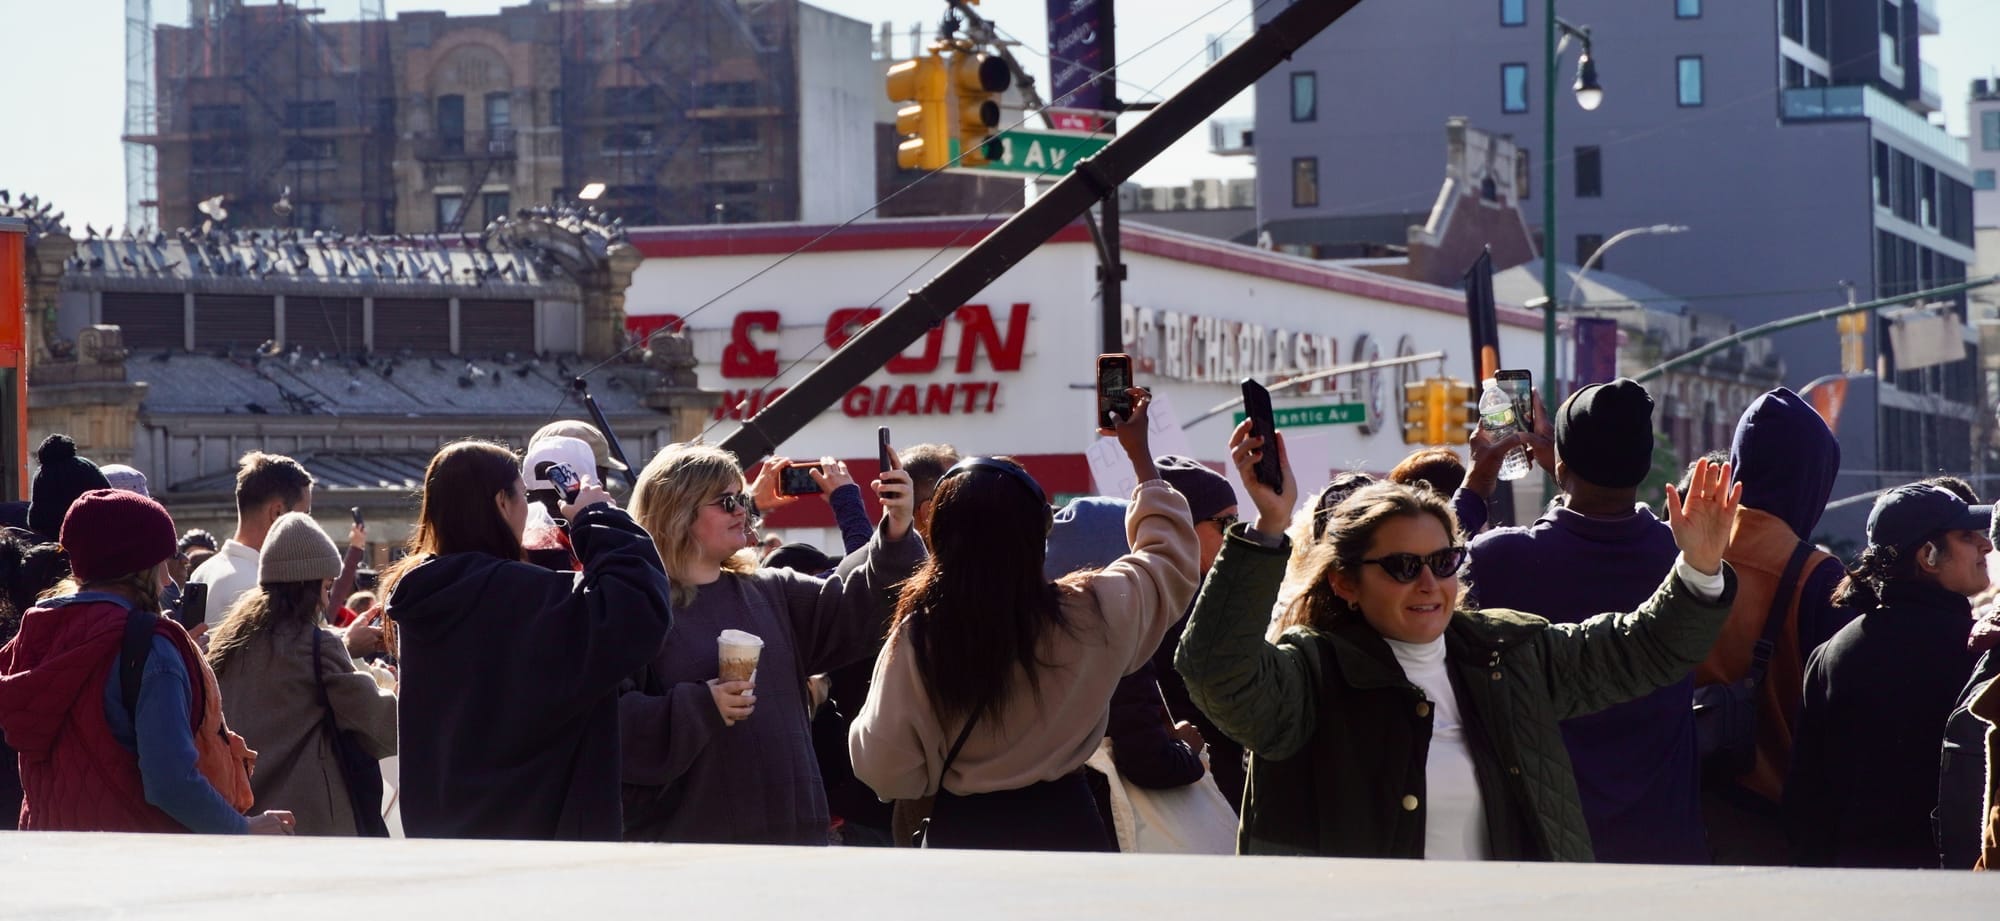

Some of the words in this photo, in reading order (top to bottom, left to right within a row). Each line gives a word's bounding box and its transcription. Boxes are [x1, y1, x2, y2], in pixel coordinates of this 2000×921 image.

[1023, 139, 1067, 170] Av
[720, 310, 781, 379] &
[841, 381, 999, 418] GIANT!
[1328, 408, 1349, 421] Av
